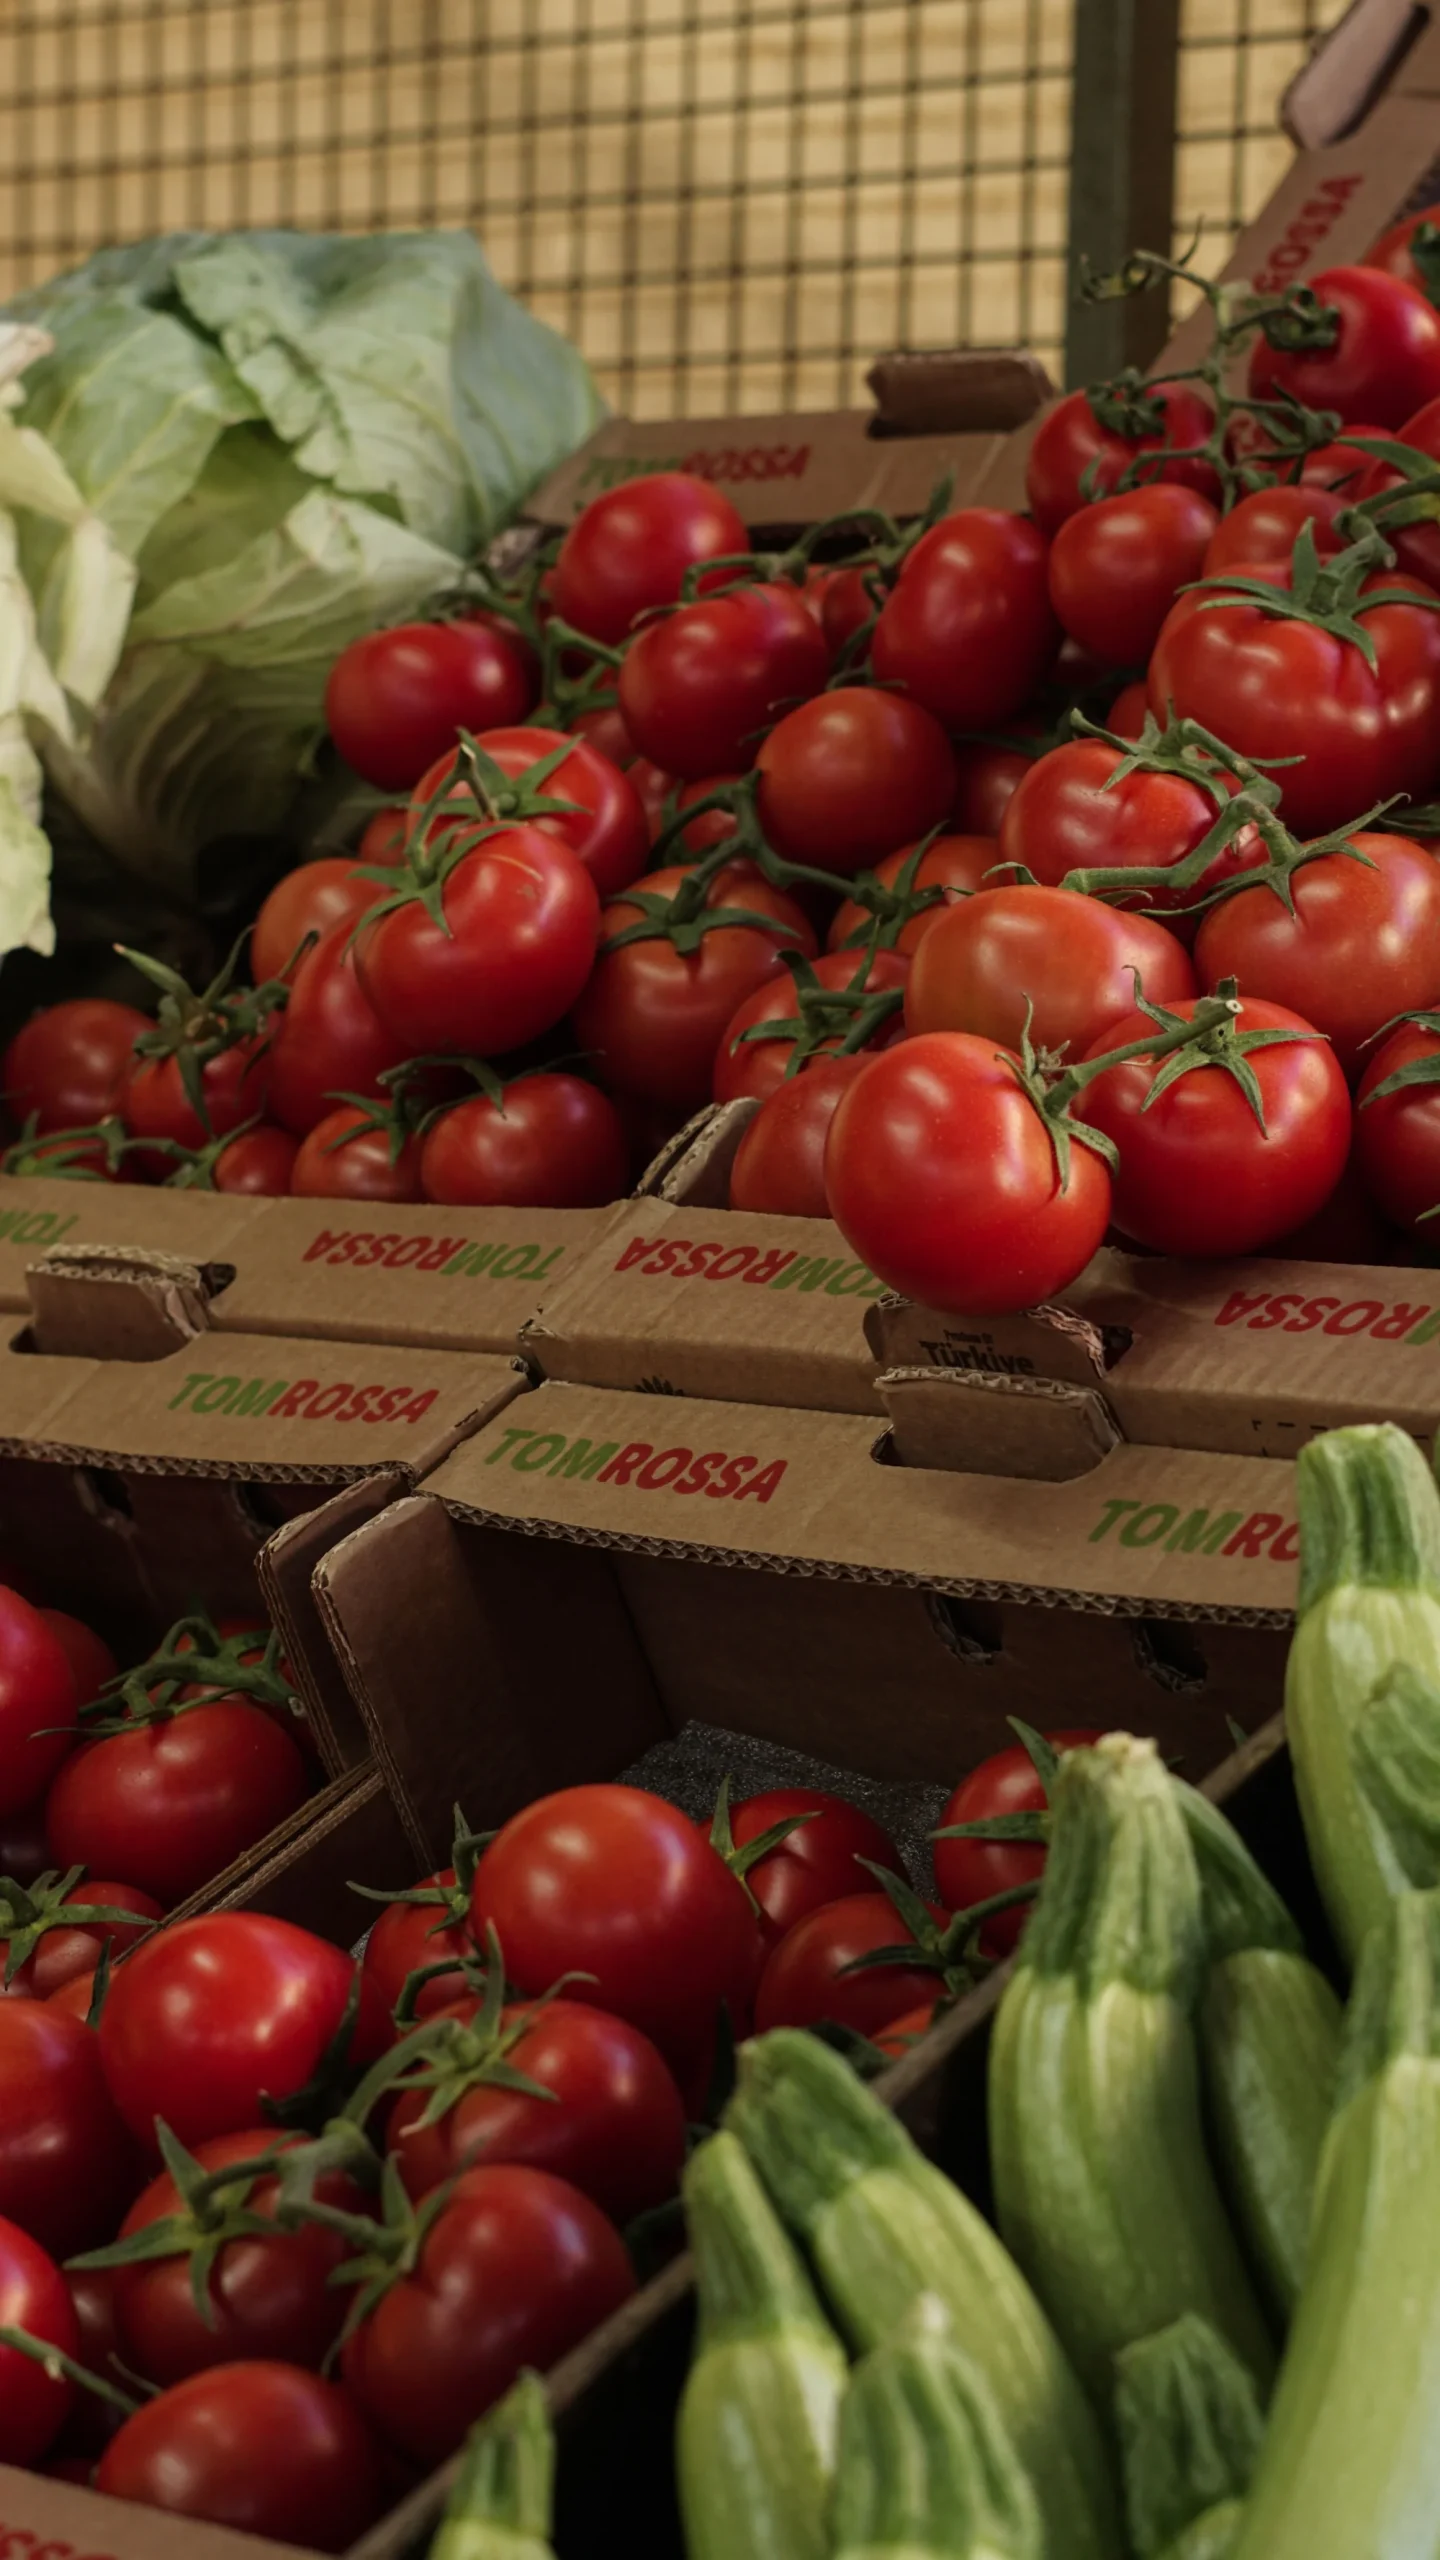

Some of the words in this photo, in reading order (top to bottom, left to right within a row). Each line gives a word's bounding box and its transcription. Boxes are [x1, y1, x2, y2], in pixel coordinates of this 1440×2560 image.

[302, 1229, 565, 1280] TOMROSSA
[919, 1340, 1036, 1375] Türkiye
[167, 1373, 440, 1424] TOMROSSA
[484, 1428, 788, 1503] TOMROSSA
